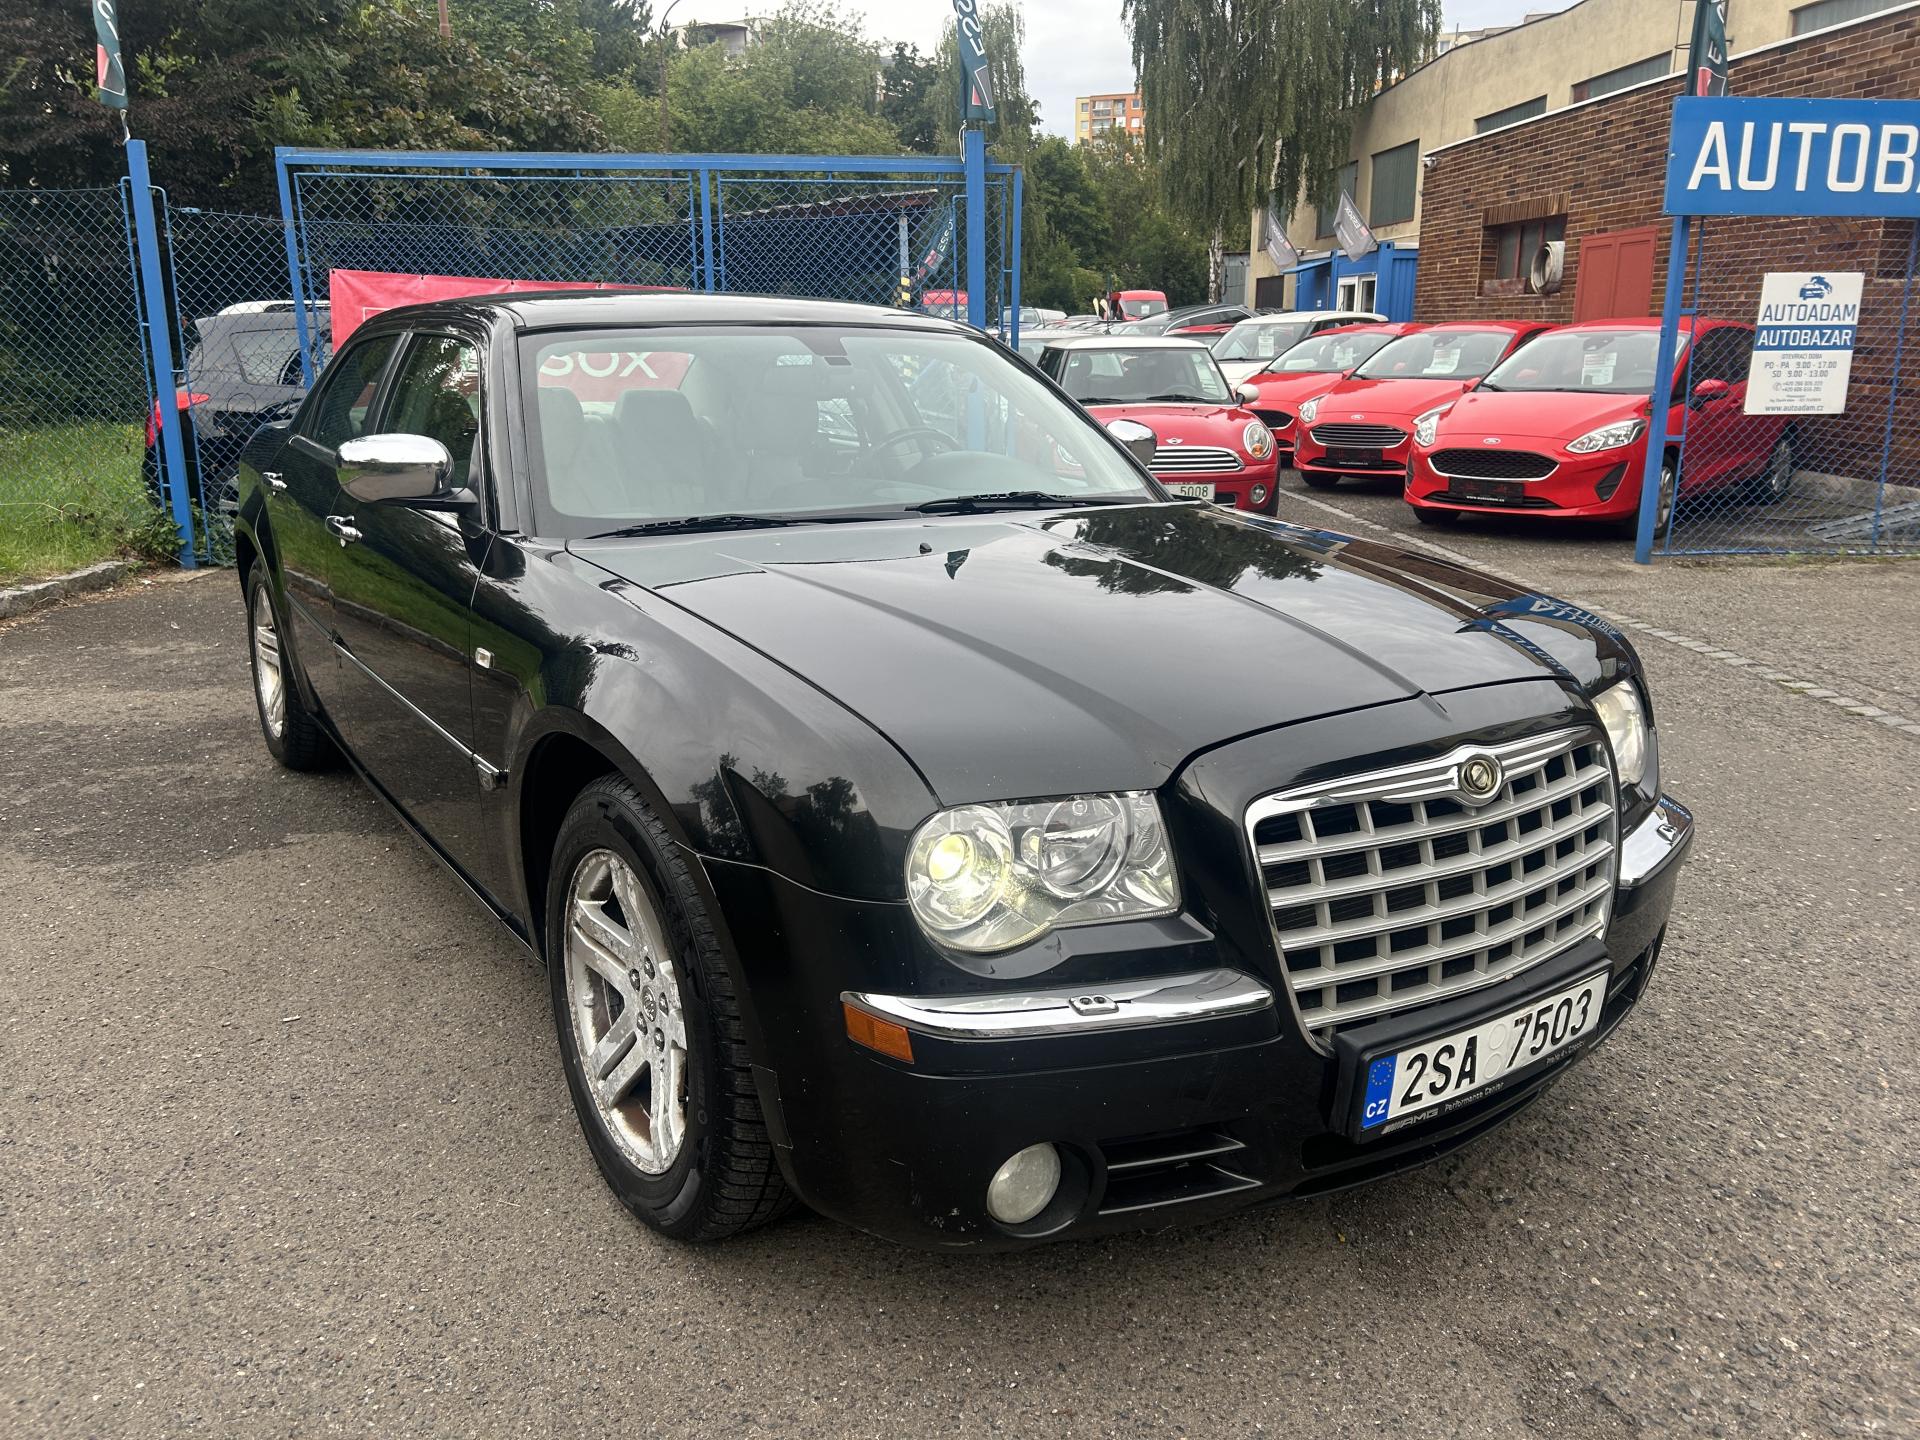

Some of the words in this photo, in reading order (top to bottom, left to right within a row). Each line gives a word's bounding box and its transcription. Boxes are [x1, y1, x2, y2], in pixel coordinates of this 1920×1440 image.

[1687, 121, 1920, 194] AUTOB
[1761, 303, 1857, 322] AUTOADAM
[1757, 329, 1852, 346] AUTOBAZAR
[1764, 361, 1775, 369] PO
[1795, 361, 1811, 369] 9.00
[1818, 361, 1838, 369] 17.00
[1772, 370, 1782, 378] SO
[1787, 370, 1803, 378] 9.00
[1809, 370, 1829, 378] 13.00
[1765, 404, 1824, 412] www.autoadam.cz
[1180, 485, 1209, 498] 5008
[1400, 1035, 1478, 1108] 2SA
[1506, 988, 1593, 1069] 7503
[1366, 1098, 1388, 1119] CZ
[1444, 1090, 1484, 1113] Performance
